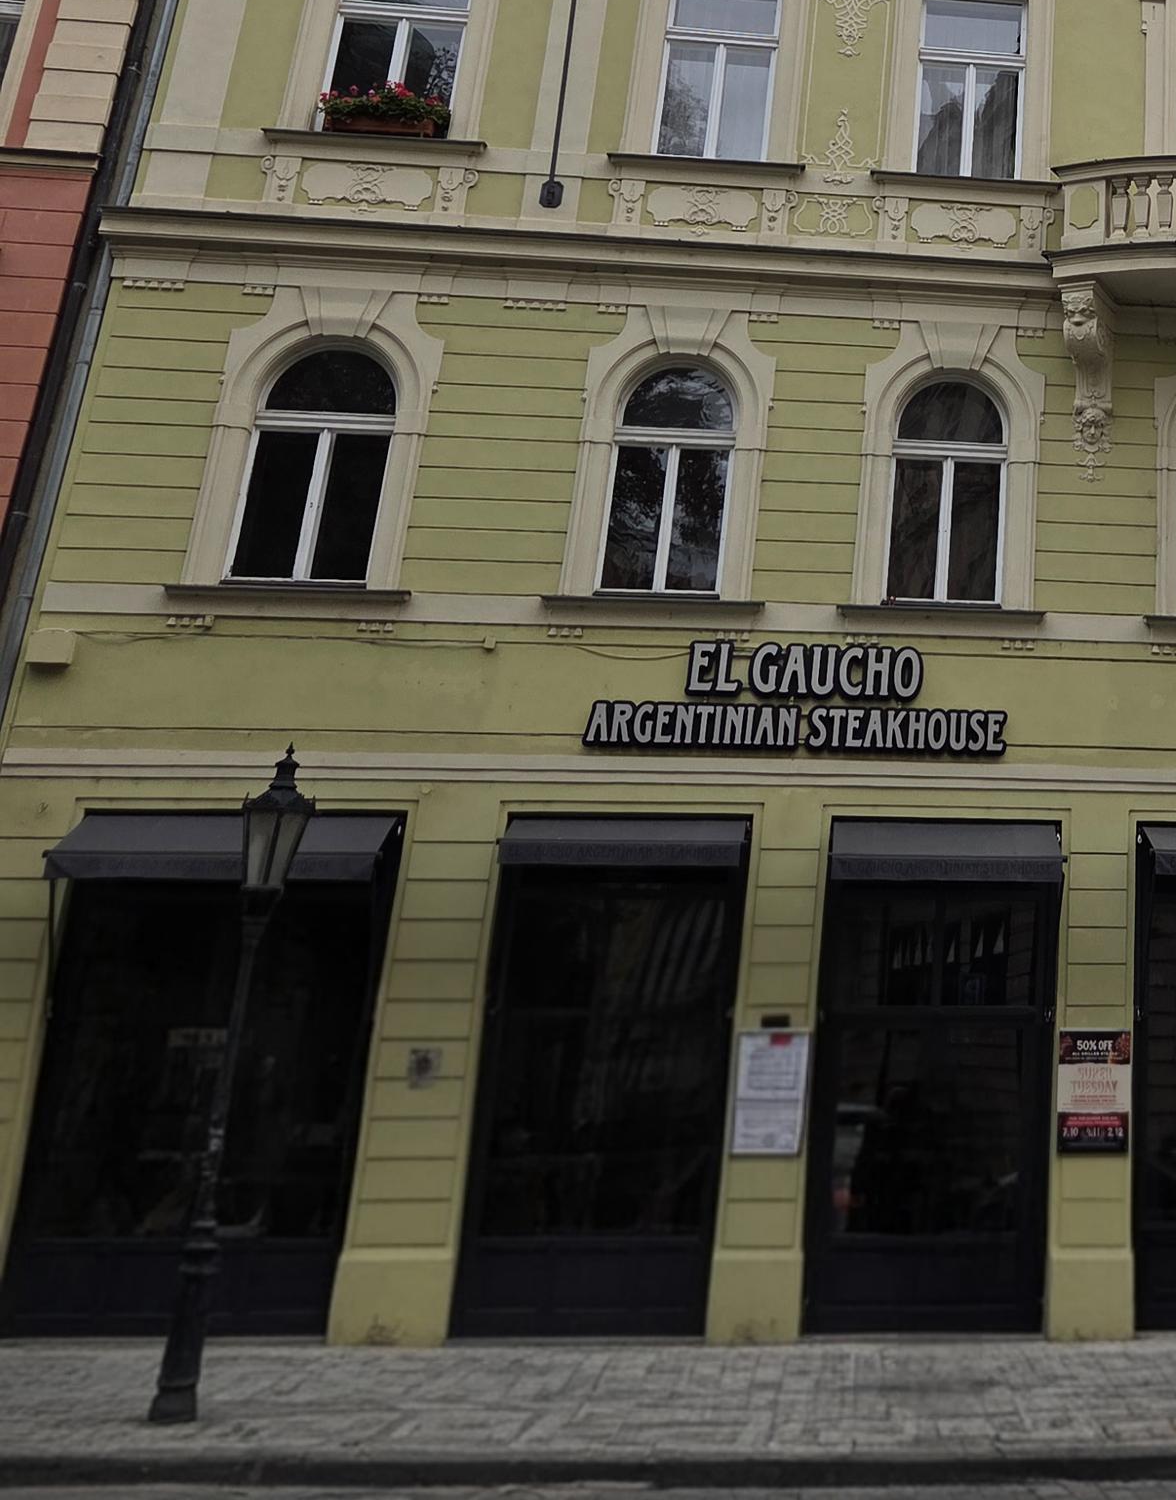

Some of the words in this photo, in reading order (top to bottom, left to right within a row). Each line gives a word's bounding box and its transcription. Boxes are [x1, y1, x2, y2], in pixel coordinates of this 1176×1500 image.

[688, 642, 740, 693] EL
[752, 643, 922, 698] GAUCHO
[586, 703, 798, 746] ARGENTINIAN
[808, 708, 1005, 752] STEAKHOUSE
[1076, 1040, 1096, 1050] 50%
[1098, 1040, 1113, 1050] OFF
[1071, 1080, 1118, 1093] TUESDAY
